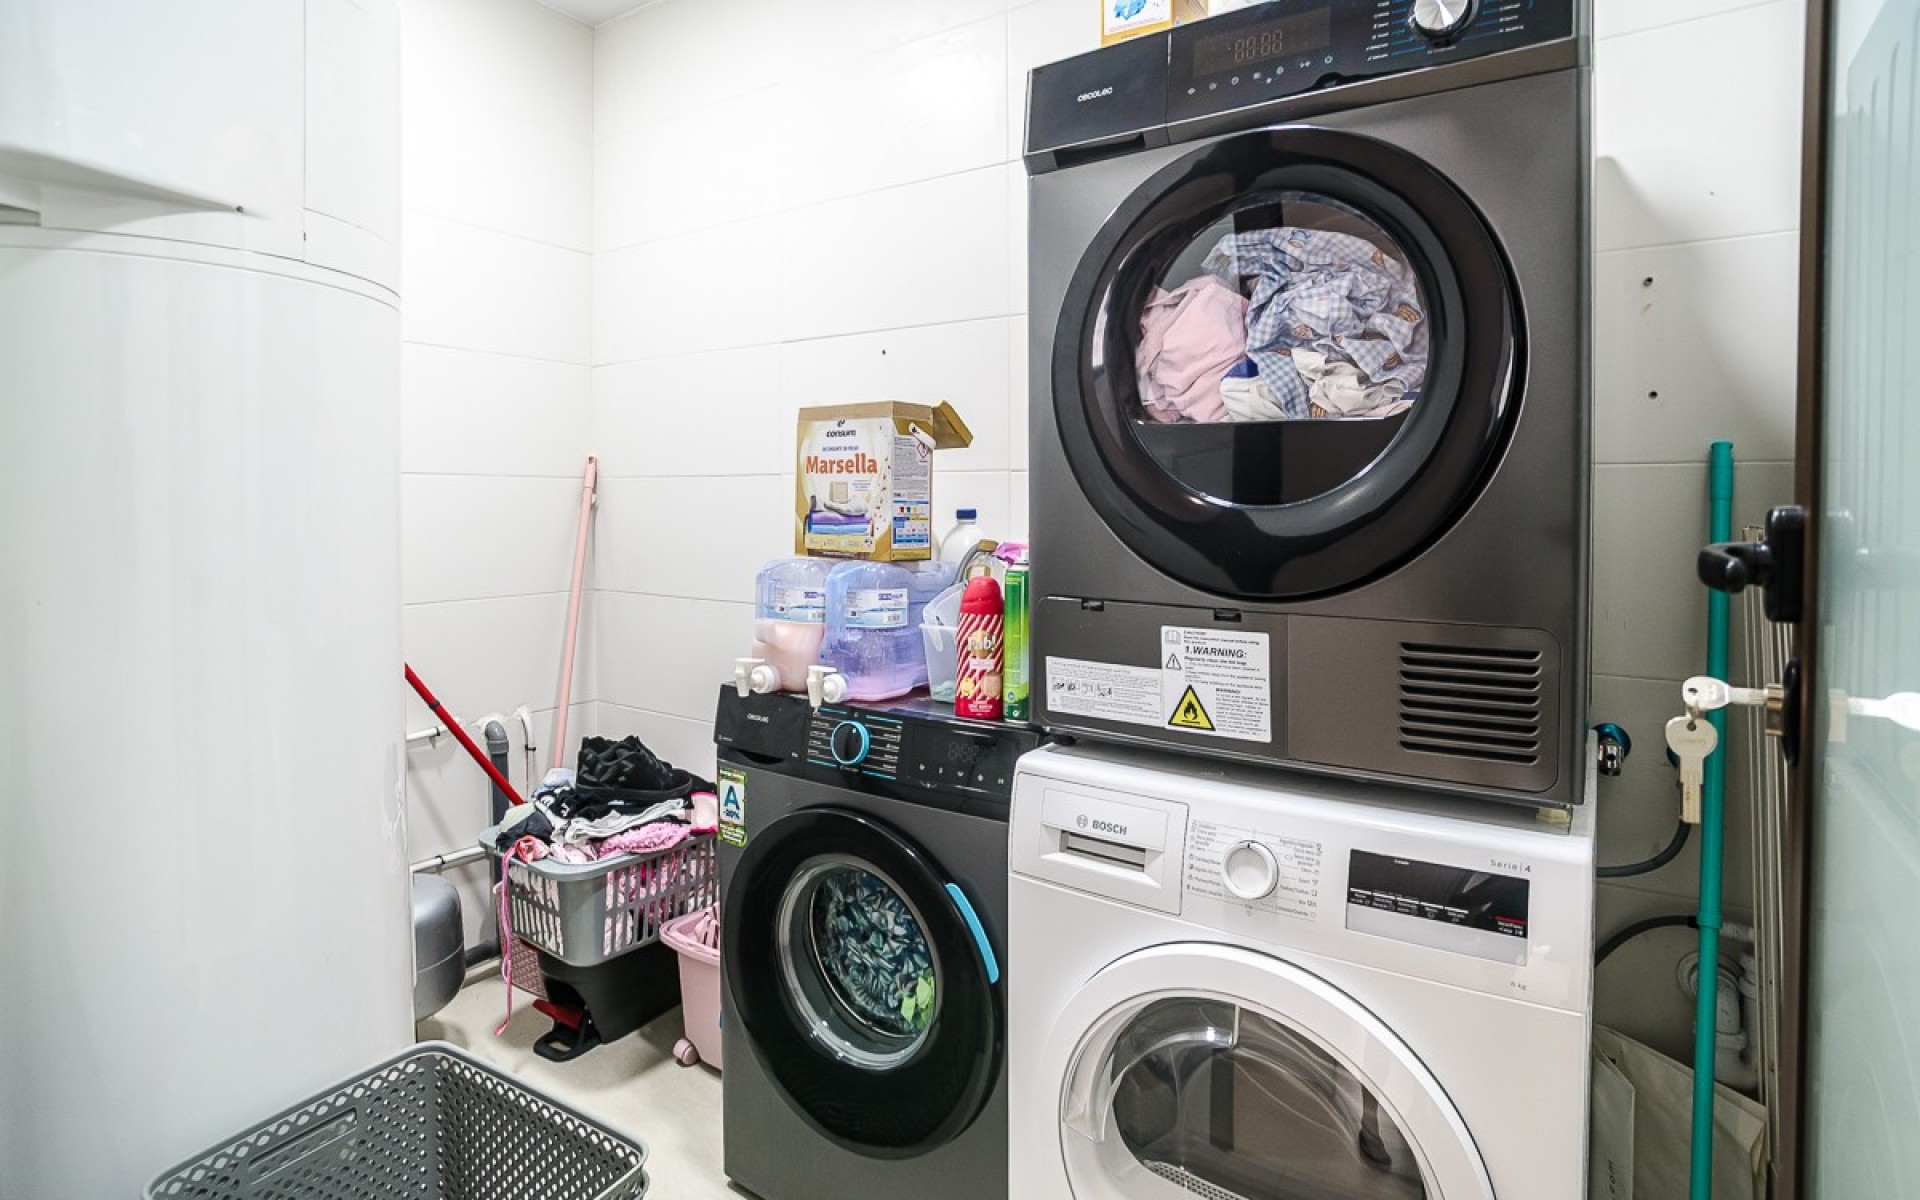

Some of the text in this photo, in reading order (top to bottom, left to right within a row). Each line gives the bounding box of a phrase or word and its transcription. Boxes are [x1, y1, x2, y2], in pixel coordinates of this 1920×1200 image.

[805, 452, 878, 475] Marsella
[1185, 645, 1247, 659] 1.WARNING:
[724, 785, 740, 810] A
[1092, 819, 1127, 836] BOSCH
[1490, 858, 1531, 873] Serie 4
